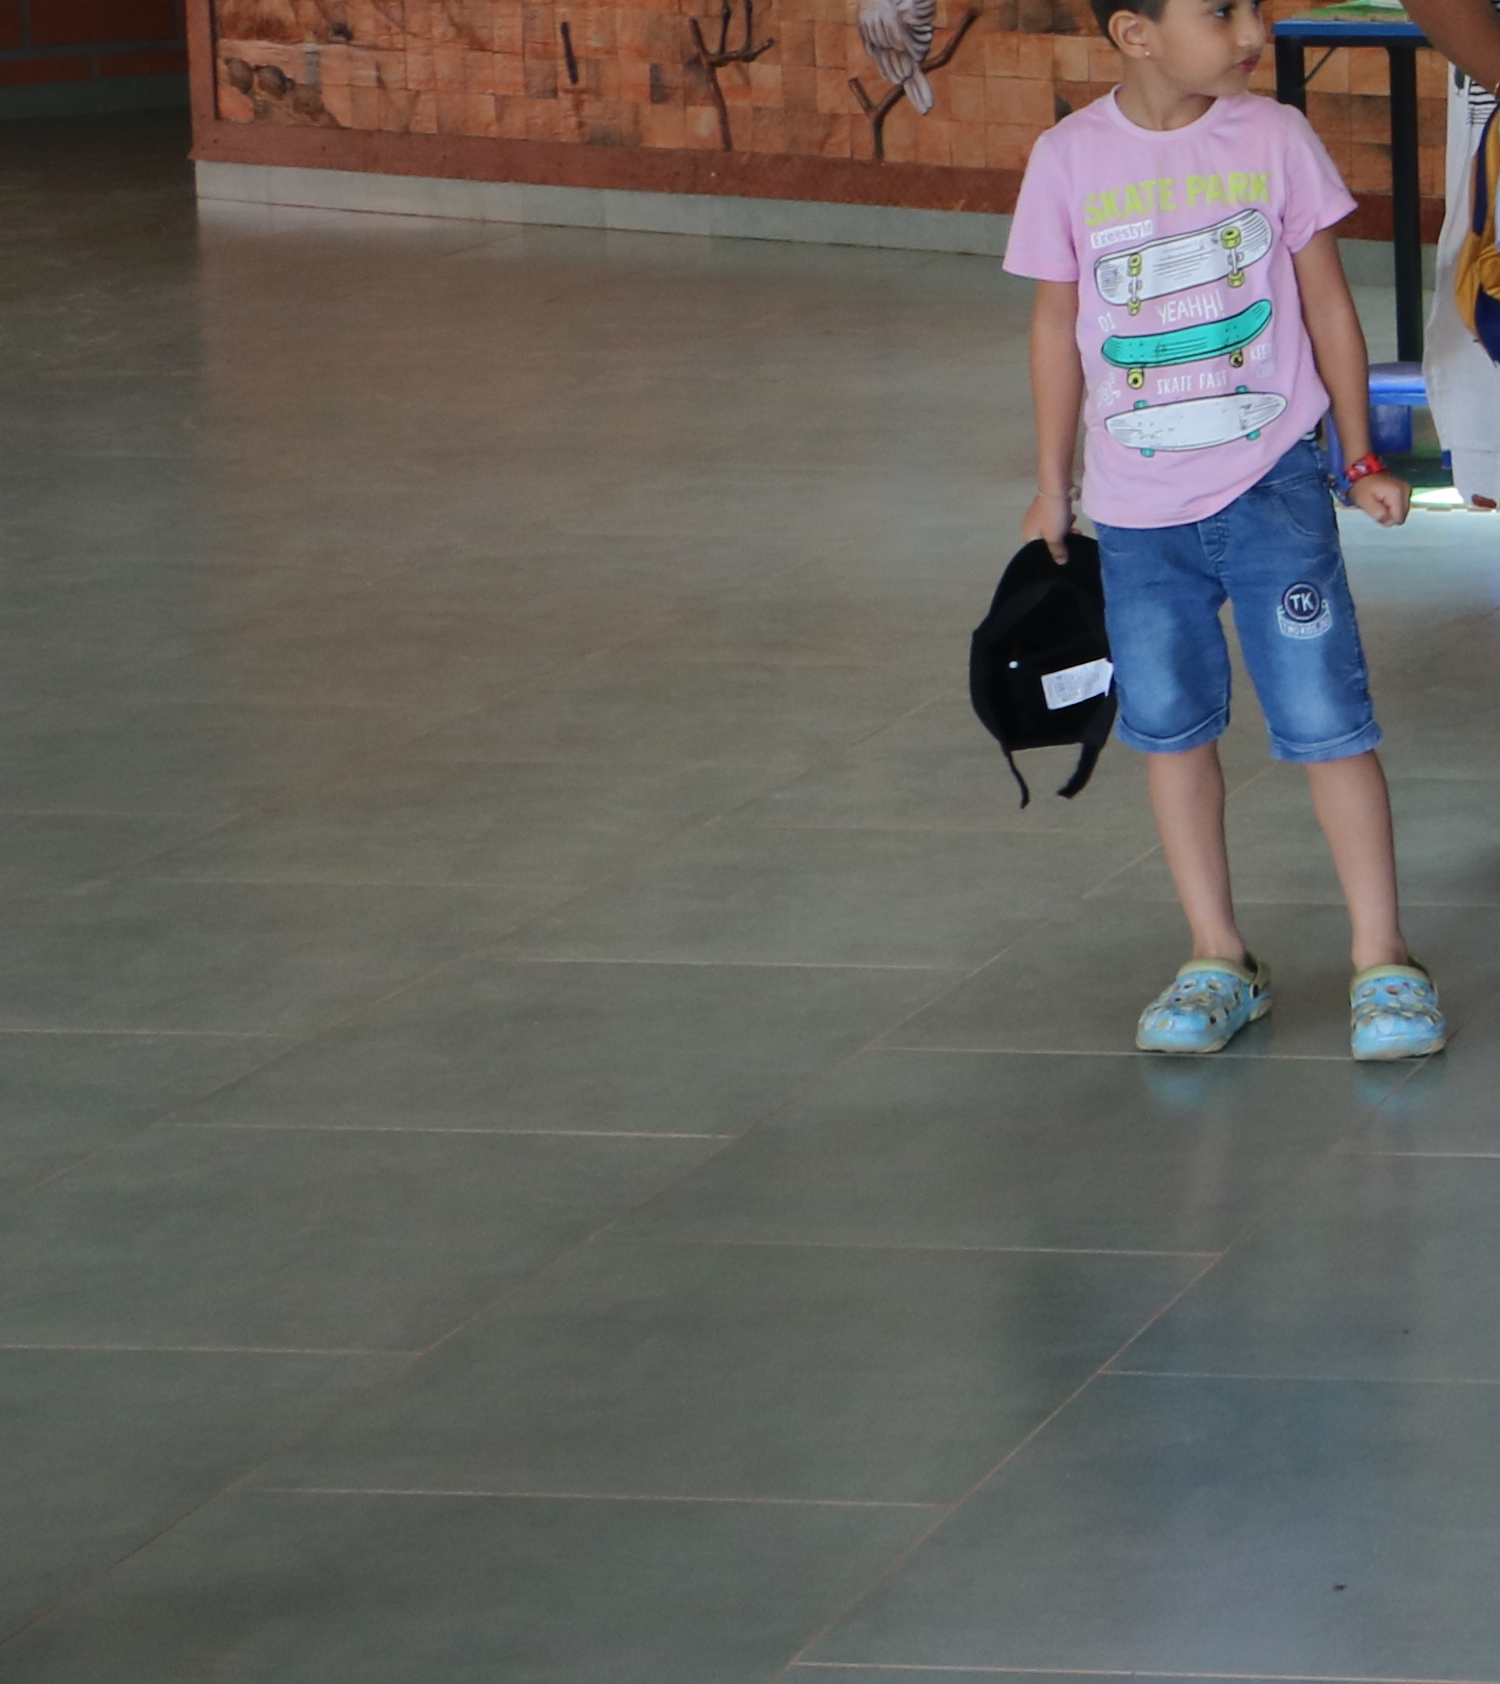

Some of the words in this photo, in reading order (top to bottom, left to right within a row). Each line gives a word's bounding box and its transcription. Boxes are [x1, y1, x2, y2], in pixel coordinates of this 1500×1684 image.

[1084, 178, 1178, 227] SKATE
[1185, 171, 1271, 208] PARK
[1155, 289, 1226, 326] YEAHH!
[1156, 374, 1193, 396] SKATE
[1199, 370, 1228, 389] FAST
[1289, 591, 1315, 612] TK
